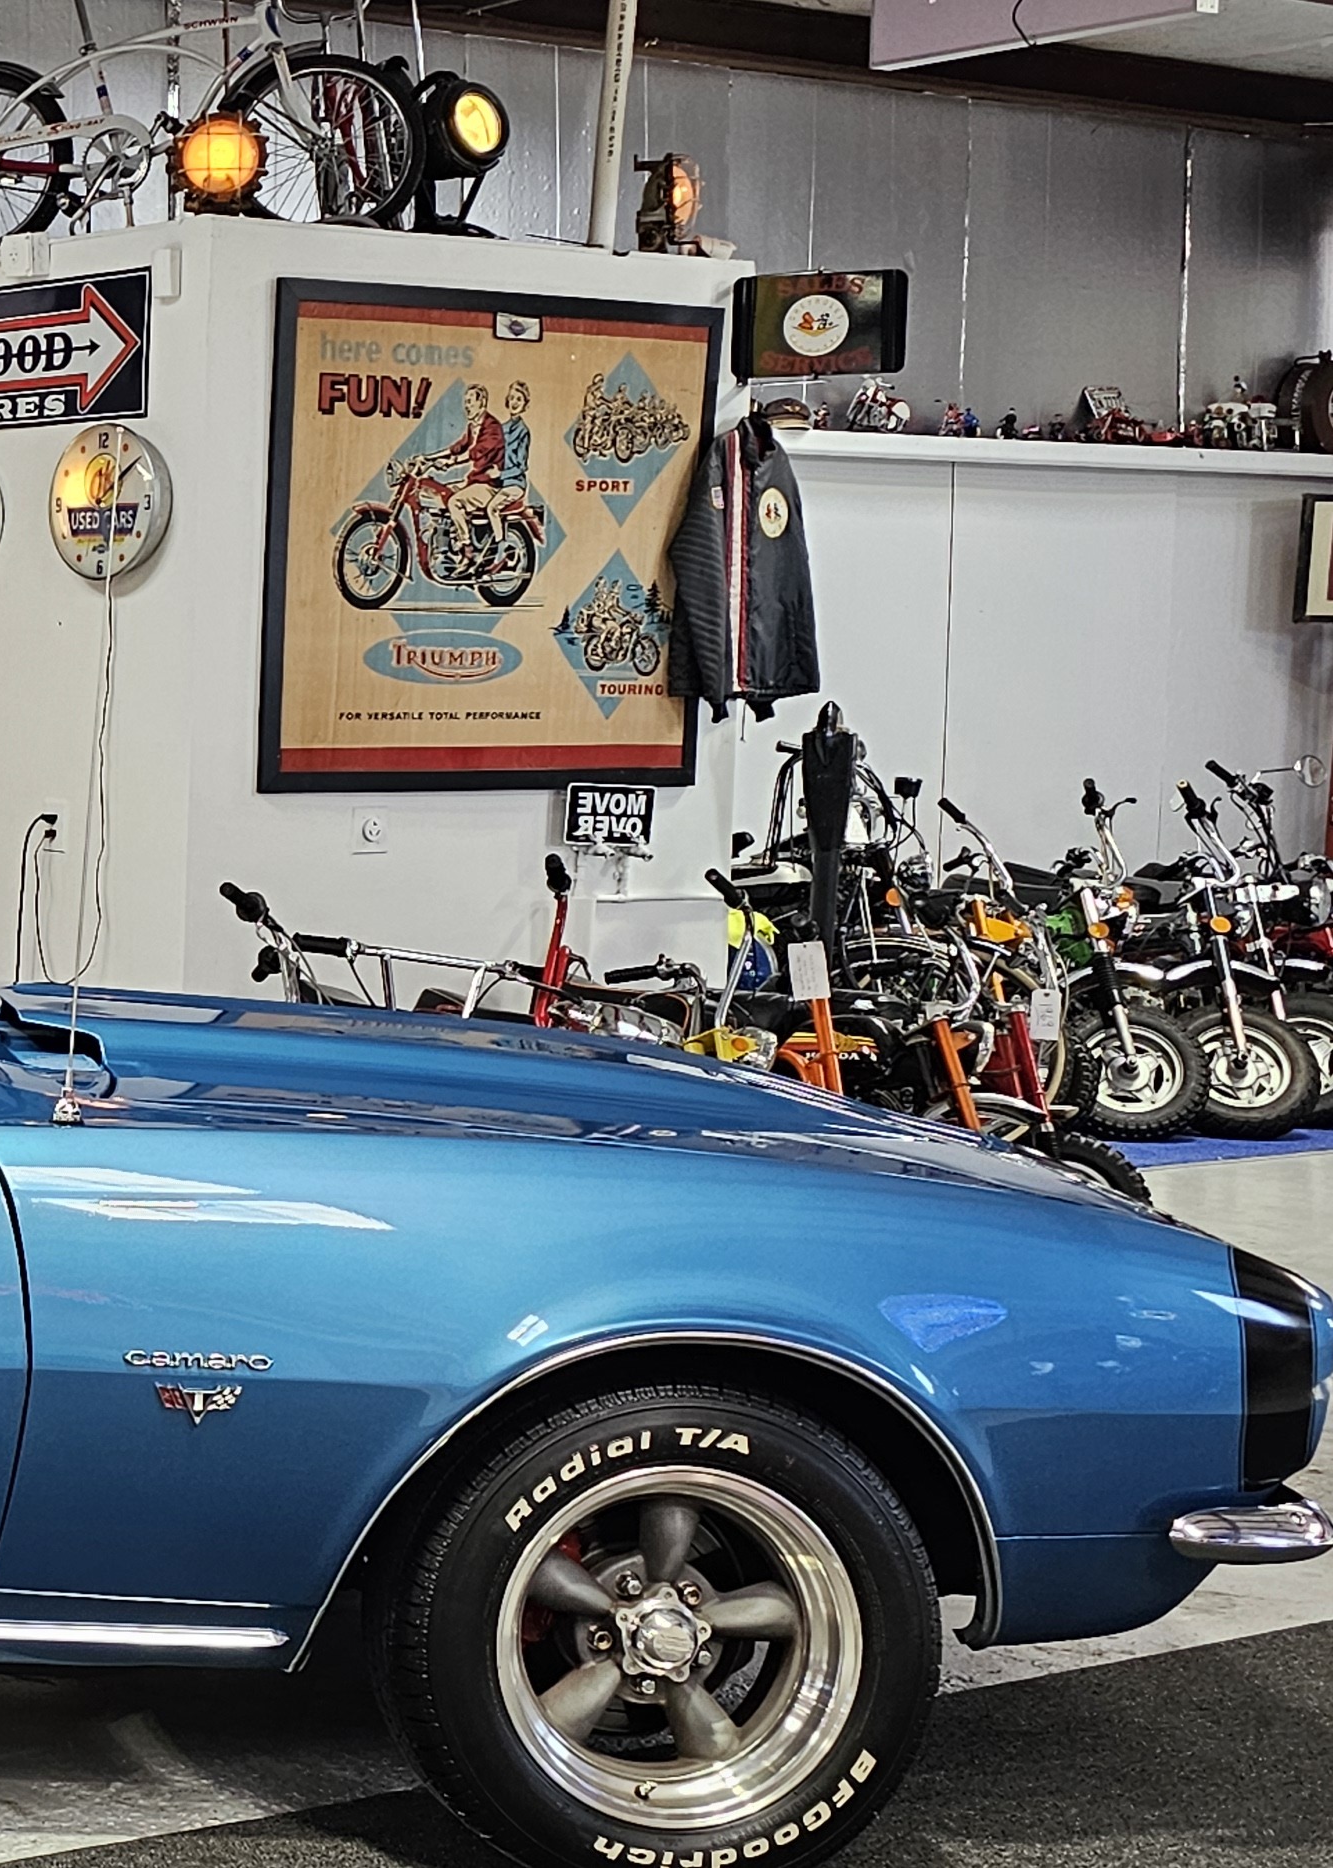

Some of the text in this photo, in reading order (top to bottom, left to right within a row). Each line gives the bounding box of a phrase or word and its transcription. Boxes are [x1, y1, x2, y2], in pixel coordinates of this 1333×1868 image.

[319, 330, 475, 368] here comes
[317, 372, 433, 419] FUN!
[98, 432, 110, 449] 12
[575, 479, 630, 493] SPORT
[71, 511, 100, 530] USED
[599, 683, 664, 696] TOURING
[338, 711, 542, 721] FOR VERSATILE TOTAL PERFORMANCE
[503, 1426, 750, 1533] Radial T/A
